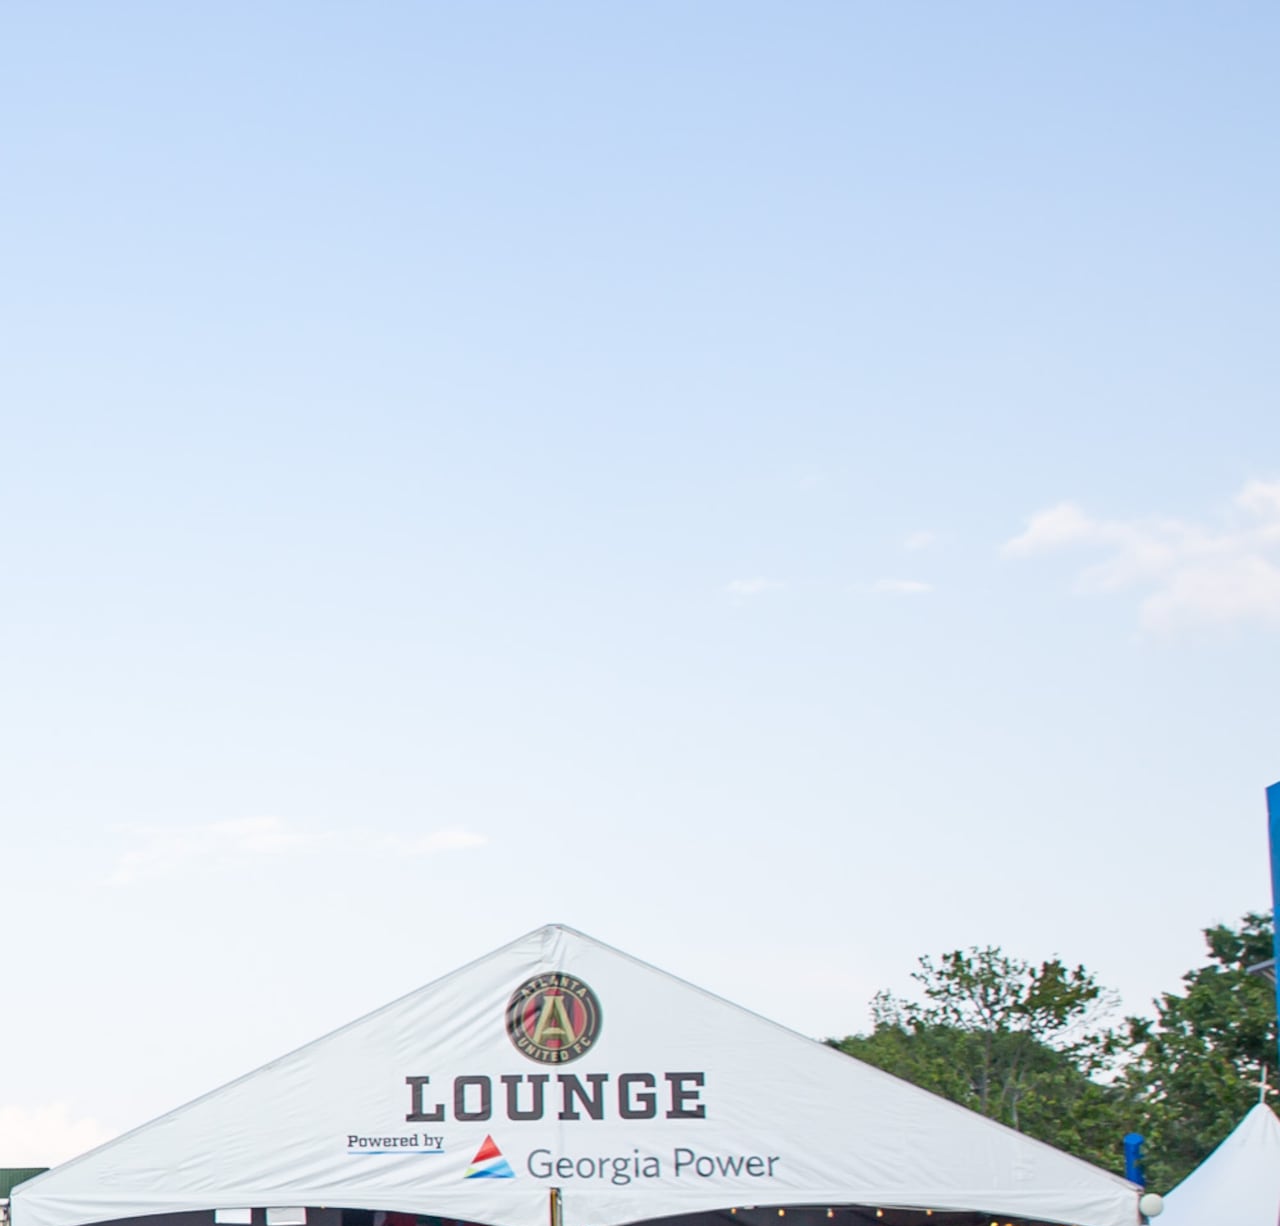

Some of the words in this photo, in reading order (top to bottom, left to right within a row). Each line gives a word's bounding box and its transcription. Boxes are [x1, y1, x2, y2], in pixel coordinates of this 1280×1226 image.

[521, 975, 588, 998] ATLANTA
[517, 1036, 569, 1062] UNITED
[575, 1036, 591, 1054] FC
[405, 1072, 706, 1122] LOUNGE
[347, 1134, 419, 1149] Powered
[424, 1133, 444, 1150] by
[527, 1148, 660, 1185] Georgia
[674, 1148, 780, 1178] Power
